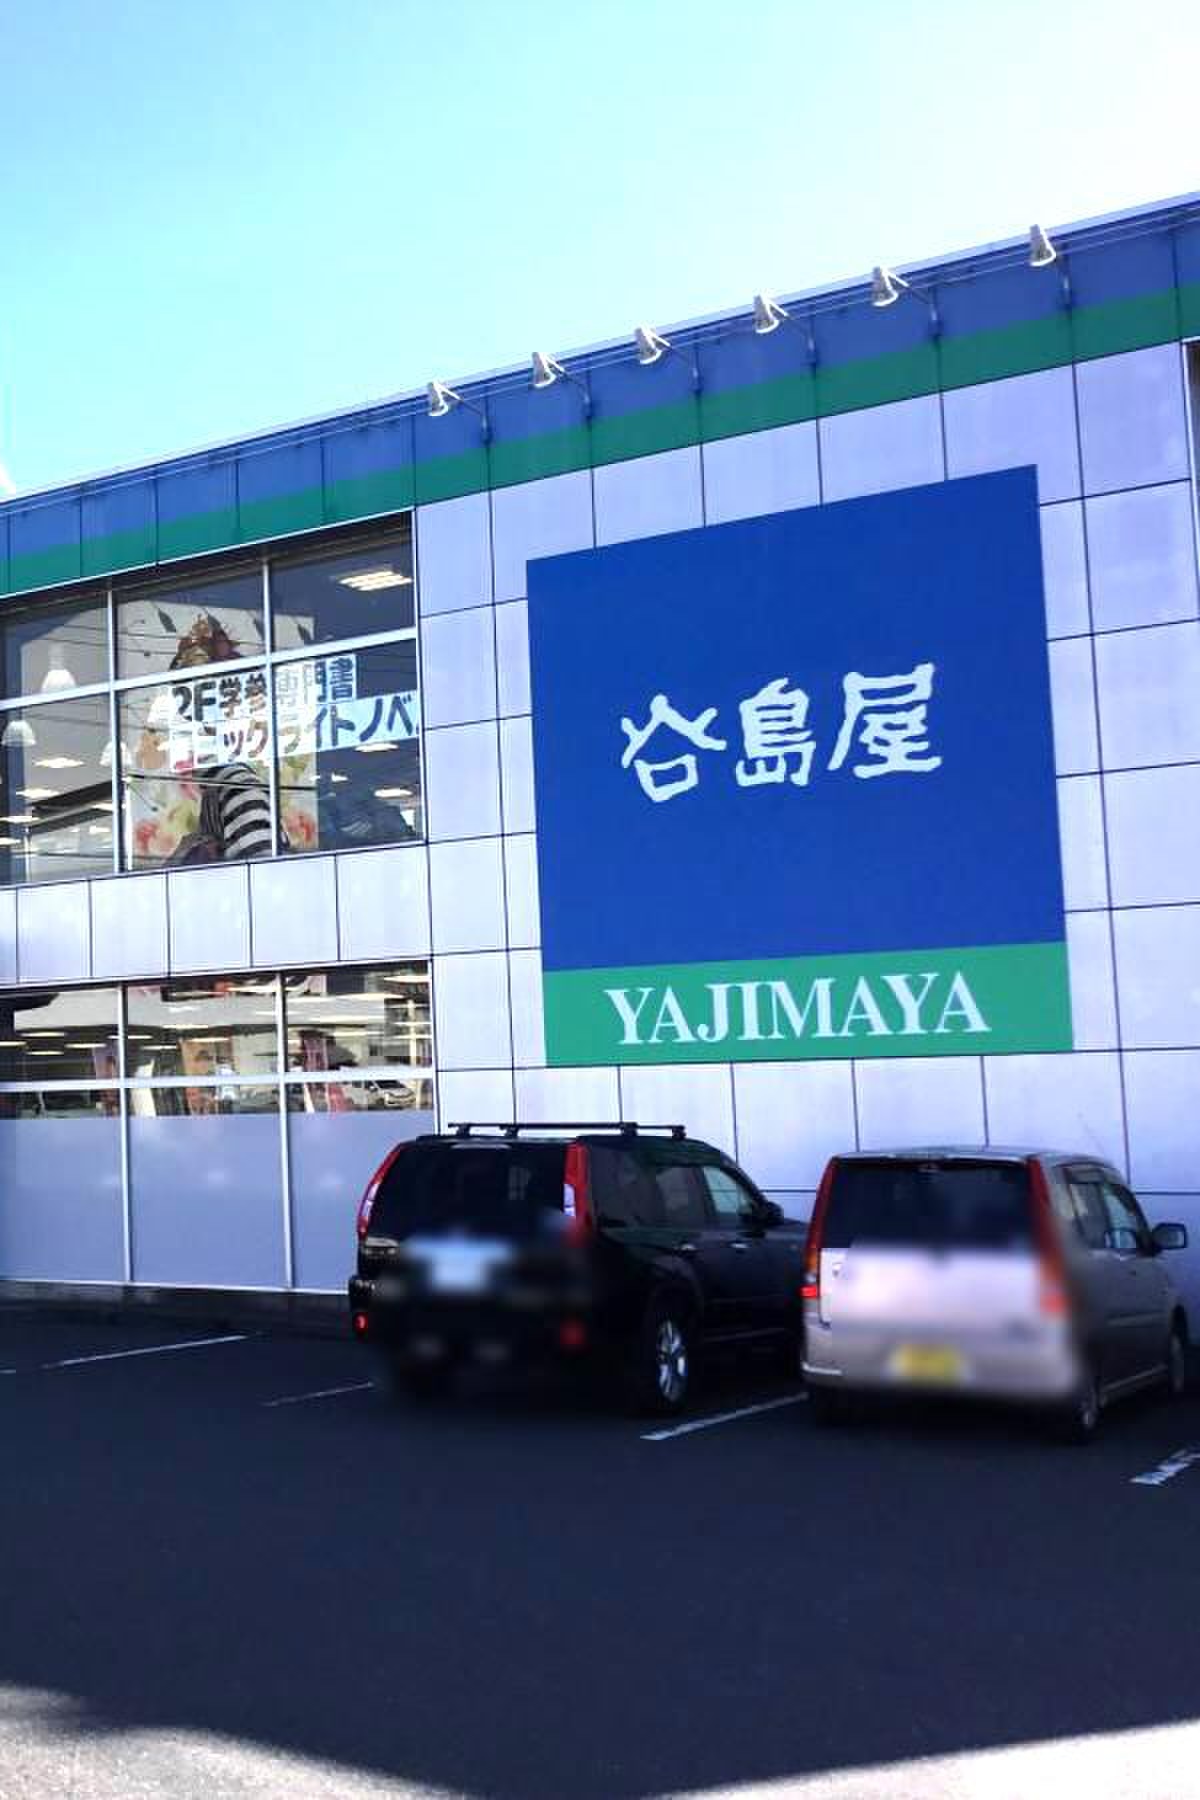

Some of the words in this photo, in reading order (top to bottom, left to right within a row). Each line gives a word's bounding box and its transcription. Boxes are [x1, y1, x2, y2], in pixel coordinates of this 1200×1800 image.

[620, 662, 943, 803] 谷島屋
[603, 970, 992, 1046] YAJIMAYA
